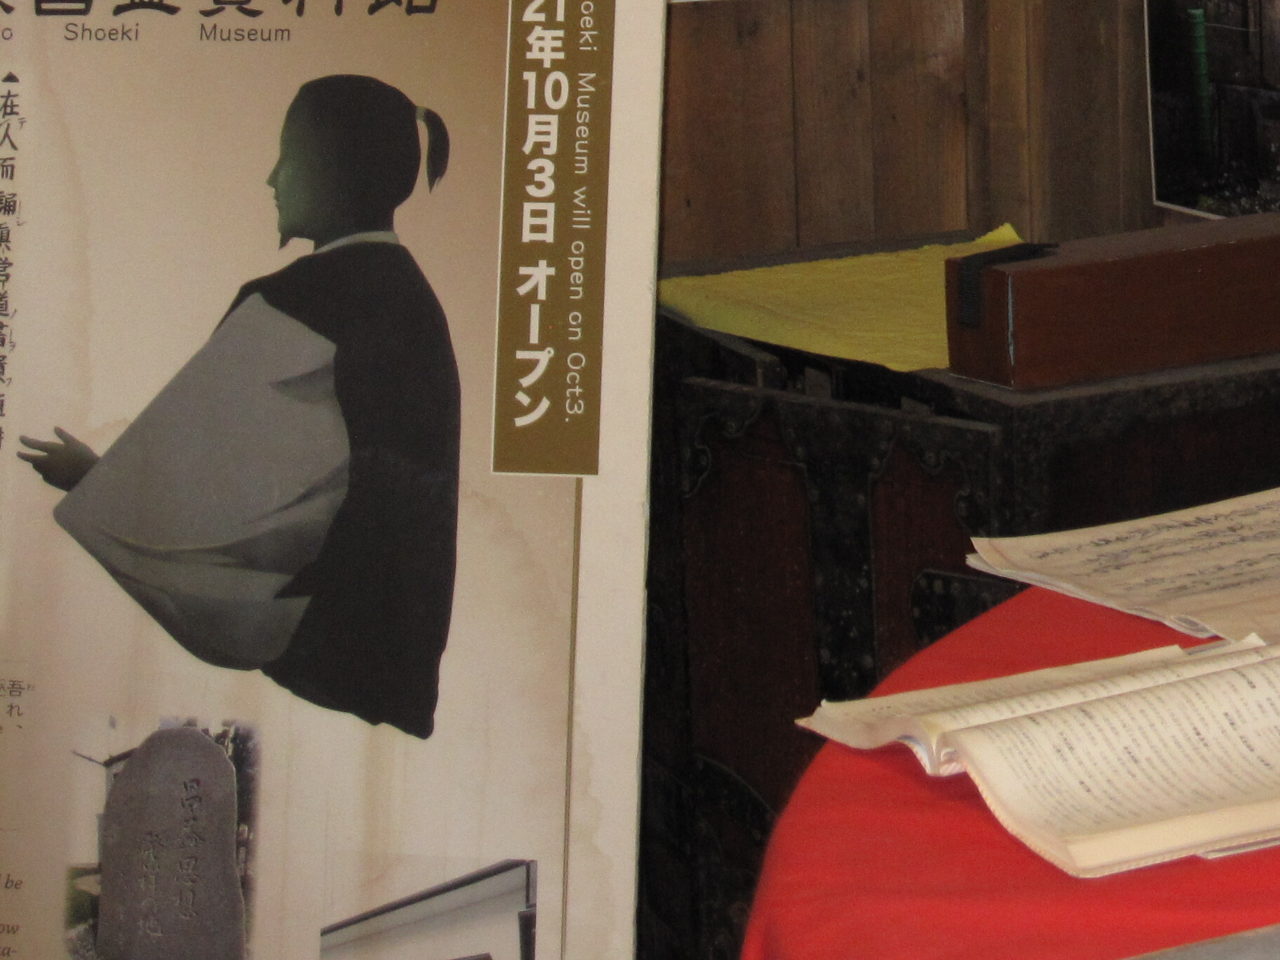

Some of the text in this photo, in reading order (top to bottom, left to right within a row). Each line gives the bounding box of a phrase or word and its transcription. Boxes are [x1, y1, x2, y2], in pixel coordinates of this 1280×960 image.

[64, 22, 291, 41] Shoeki Museum
[575, 73, 596, 176] Museum
[572, 186, 592, 231] will
[568, 240, 588, 301] open
[513, 262, 558, 429] オープン
[568, 312, 585, 341] on
